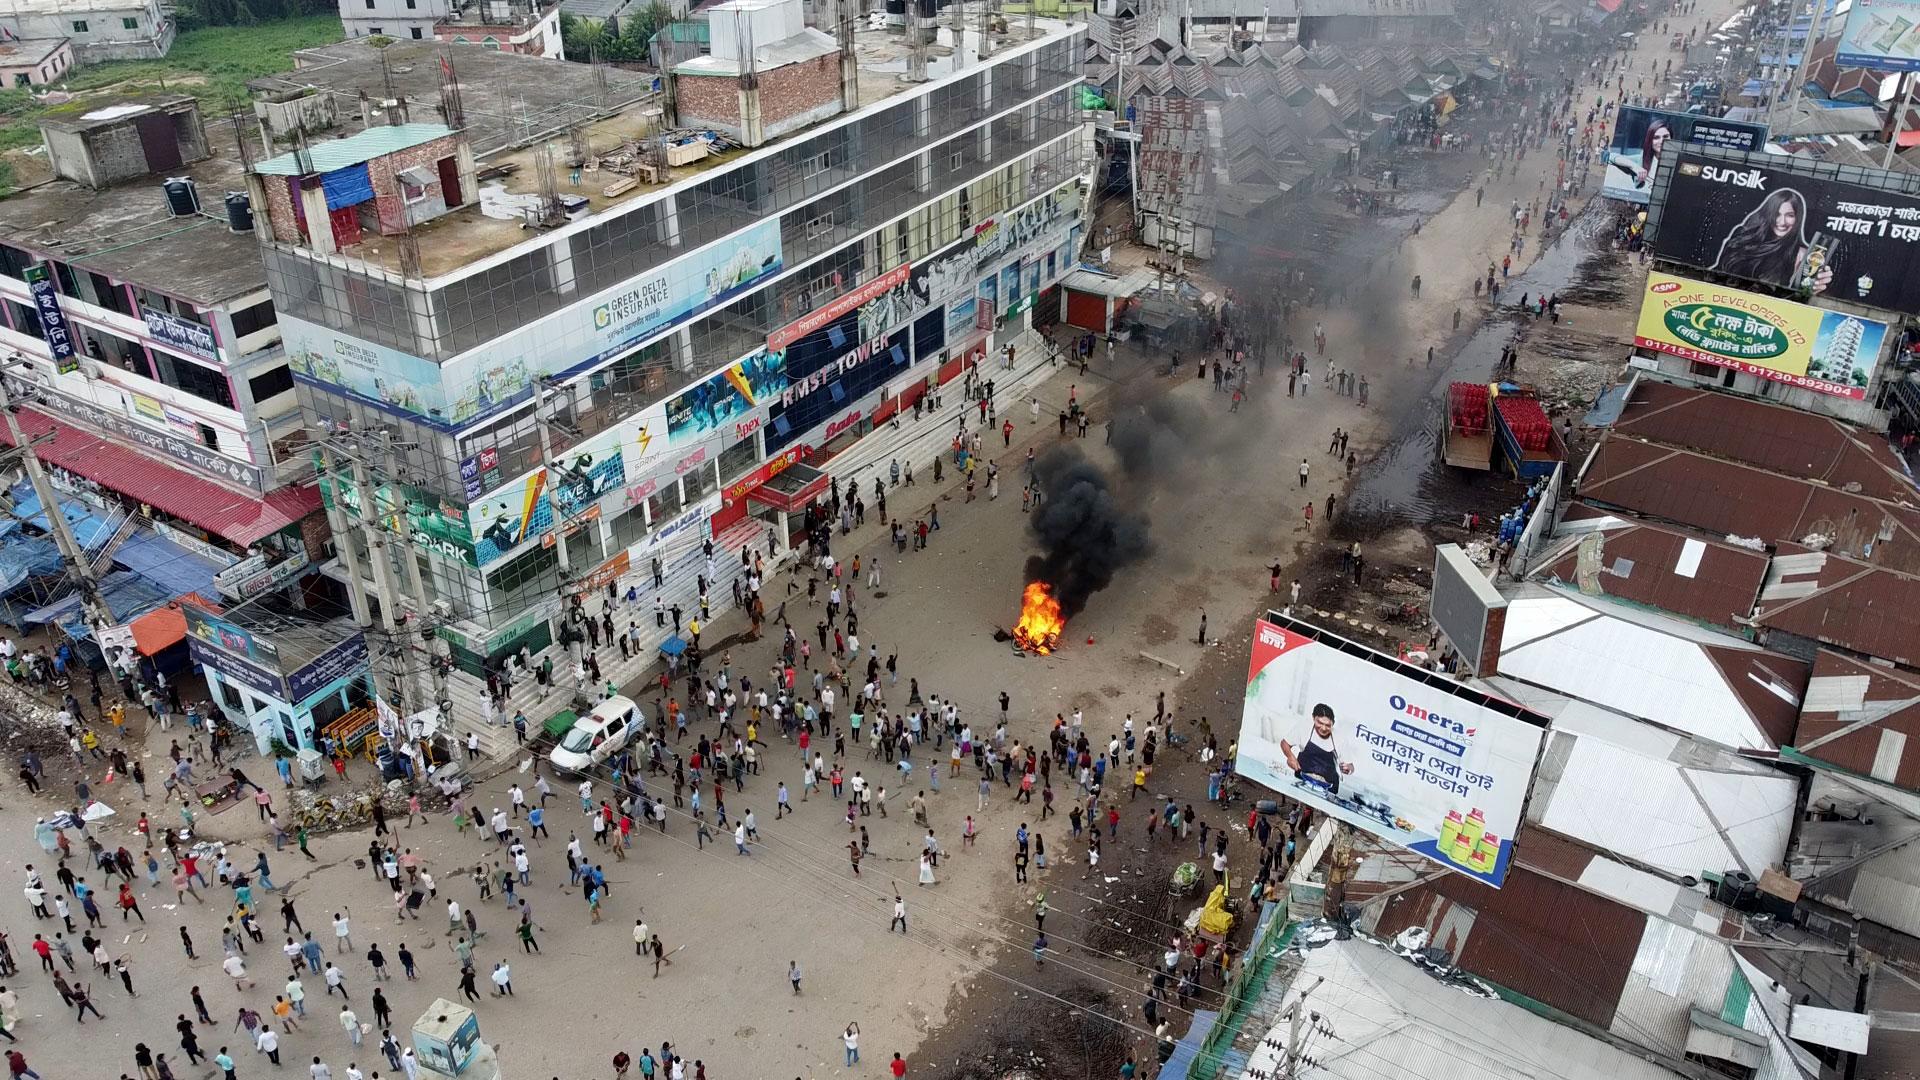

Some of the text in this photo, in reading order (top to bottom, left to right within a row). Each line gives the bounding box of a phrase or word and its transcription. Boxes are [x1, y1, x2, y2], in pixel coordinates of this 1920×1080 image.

[1701, 165, 1768, 190] sunsilk
[1836, 201, 1893, 219] নজরকাড়া
[1826, 216, 1874, 235] নাম্বার
[1877, 219, 1889, 237] 1
[611, 277, 667, 311] GREEN DELTA
[612, 288, 669, 323] INSURANCE
[1663, 294, 1705, 309] A-ONE
[1712, 294, 1788, 328] DEVELOPERS
[1676, 324, 1778, 354] রেডি ফ্ল্যাটের মালিক
[1714, 313, 1743, 332] লক্ষ
[1744, 316, 1776, 340] টাকা
[836, 332, 889, 375] TOWER
[1748, 365, 1852, 396] 01730-892904
[669, 406, 692, 425] IGNITE
[736, 416, 760, 441] Apex
[165, 437, 188, 458] নিউ
[190, 449, 228, 474] মার্কেট
[634, 451, 661, 469] SPRINT
[1389, 695, 1465, 734] Omera
[346, 720, 376, 742] WALTON
[1356, 723, 1494, 791] নিরাপত্তায় সেরা তাই
[1372, 750, 1470, 797] আস্থা শতভাগ
